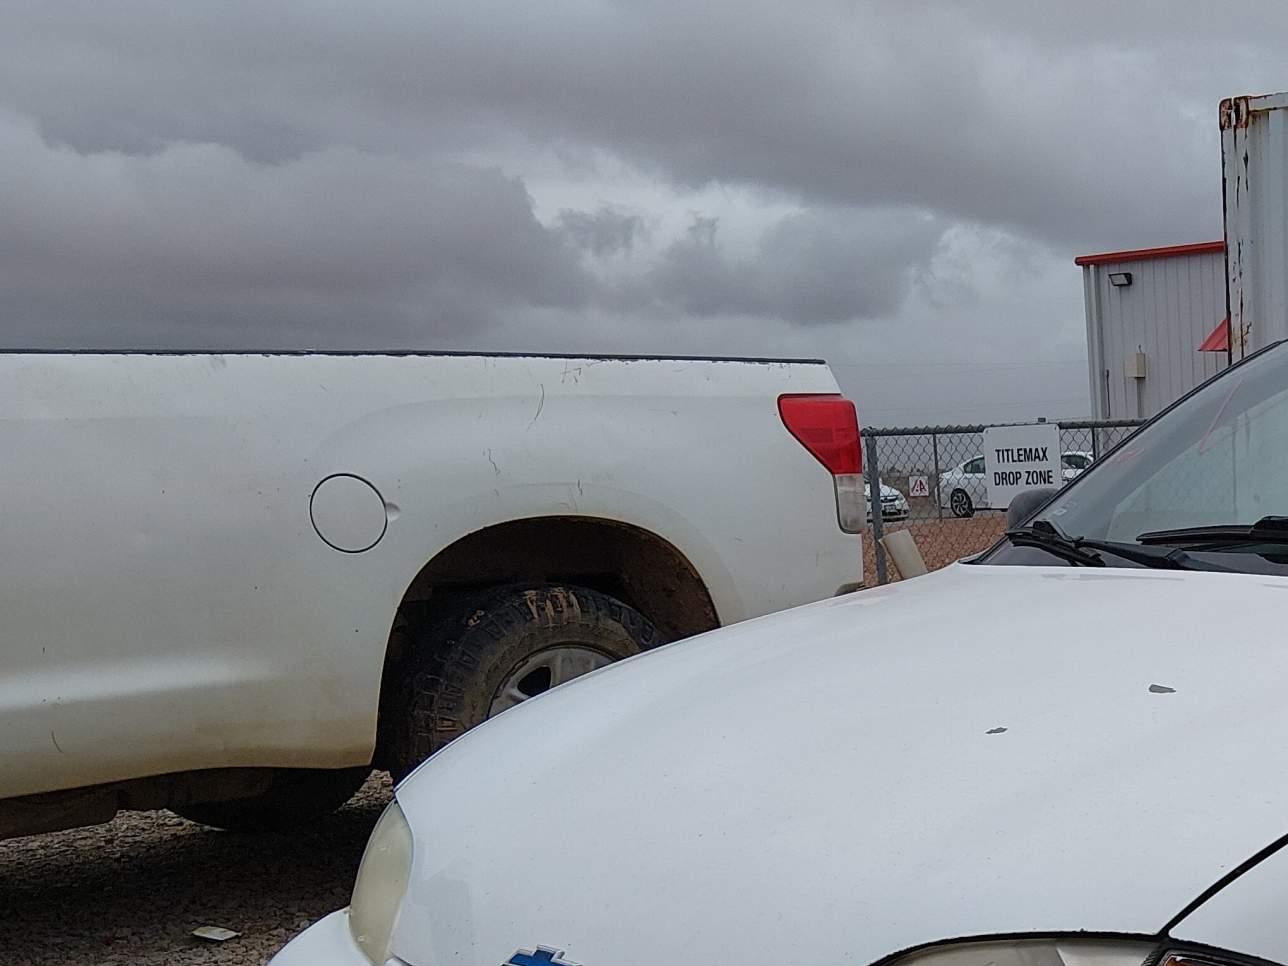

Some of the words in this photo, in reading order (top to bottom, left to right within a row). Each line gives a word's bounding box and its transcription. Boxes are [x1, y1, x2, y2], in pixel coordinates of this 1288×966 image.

[995, 447, 1049, 463] TITLEMAX
[993, 471, 1022, 486] DROP
[1025, 470, 1053, 485] ZONE
